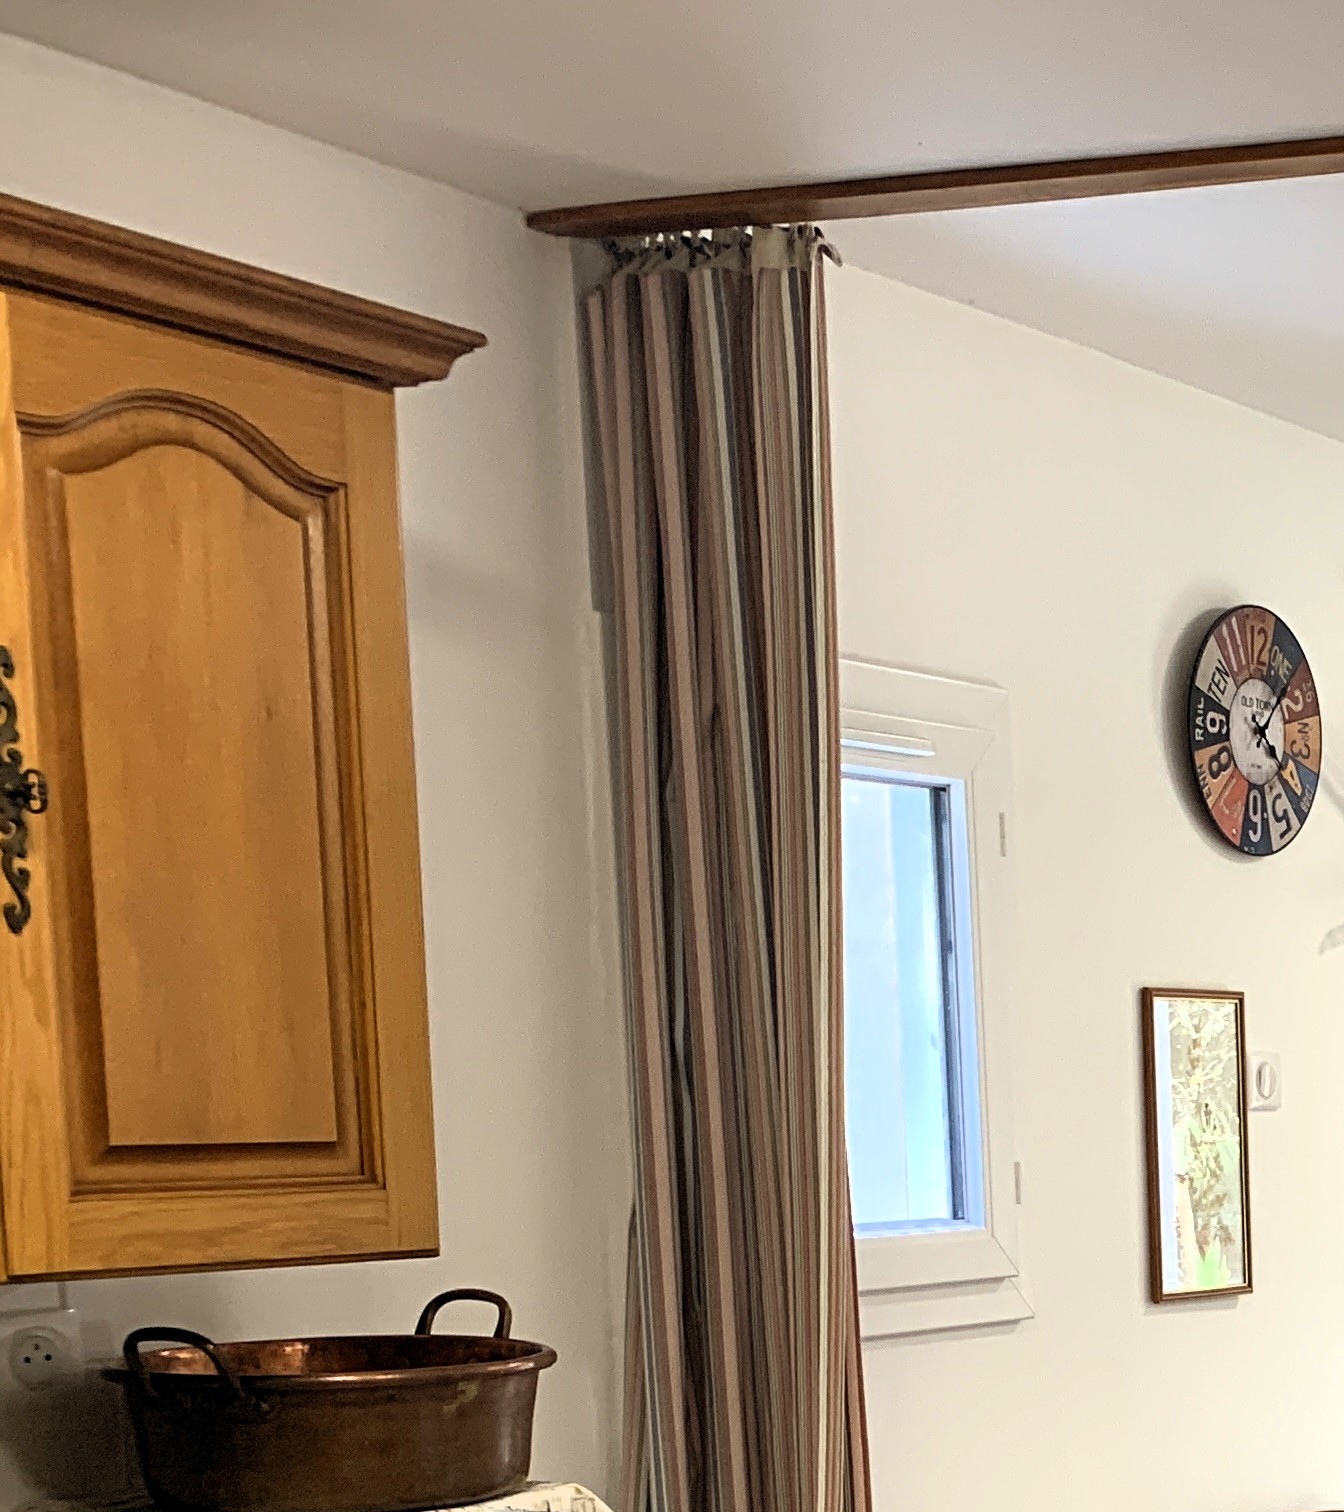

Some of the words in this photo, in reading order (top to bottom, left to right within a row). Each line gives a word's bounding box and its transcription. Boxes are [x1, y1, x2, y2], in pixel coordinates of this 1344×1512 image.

[1250, 624, 1268, 667] 12
[1270, 645, 1293, 684] ONE
[1207, 658, 1230, 703] TEN
[1194, 696, 1205, 741] RAIL
[1241, 695, 1254, 708] OLD
[1281, 688, 1304, 720] 2
[1206, 710, 1228, 735] 9
[1208, 745, 1231, 780] 8
[1248, 788, 1262, 843] 6
[1271, 792, 1292, 841] 5
